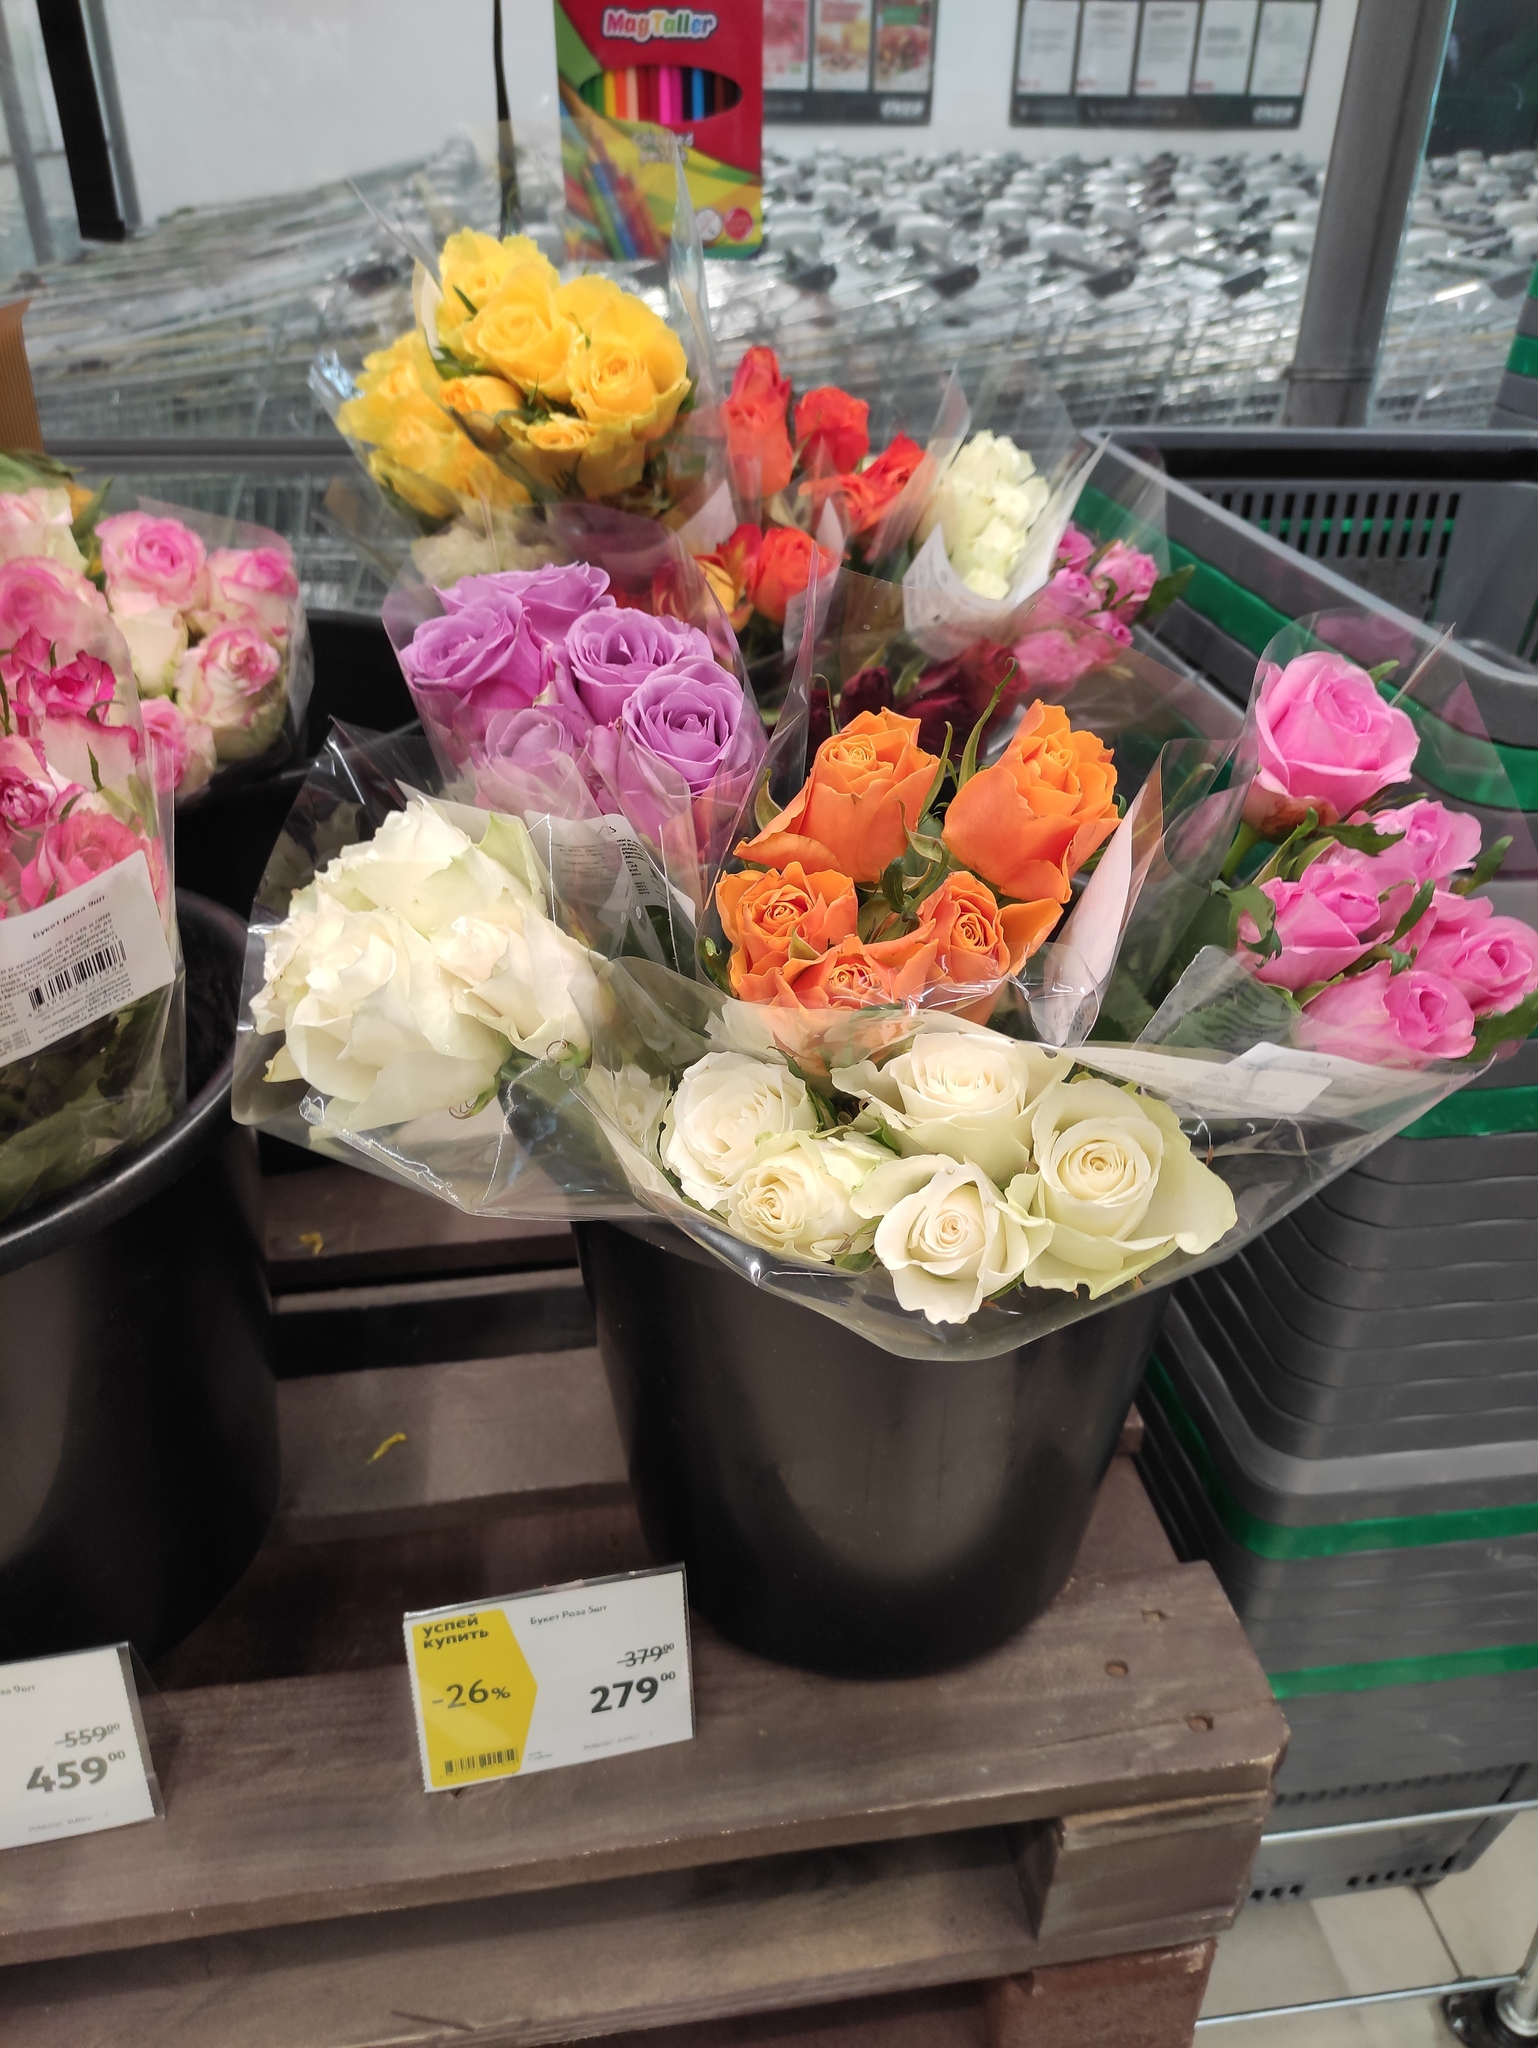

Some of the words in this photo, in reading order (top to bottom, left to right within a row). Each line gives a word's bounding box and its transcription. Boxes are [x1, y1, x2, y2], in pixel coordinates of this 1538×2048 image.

[603, 9, 717, 42] MagTaller
[422, 1613, 479, 1639] успей
[530, 1614, 561, 1627] Букет
[562, 1608, 586, 1619] Роза
[588, 1604, 608, 1613] 5шт
[423, 1628, 490, 1650] купить
